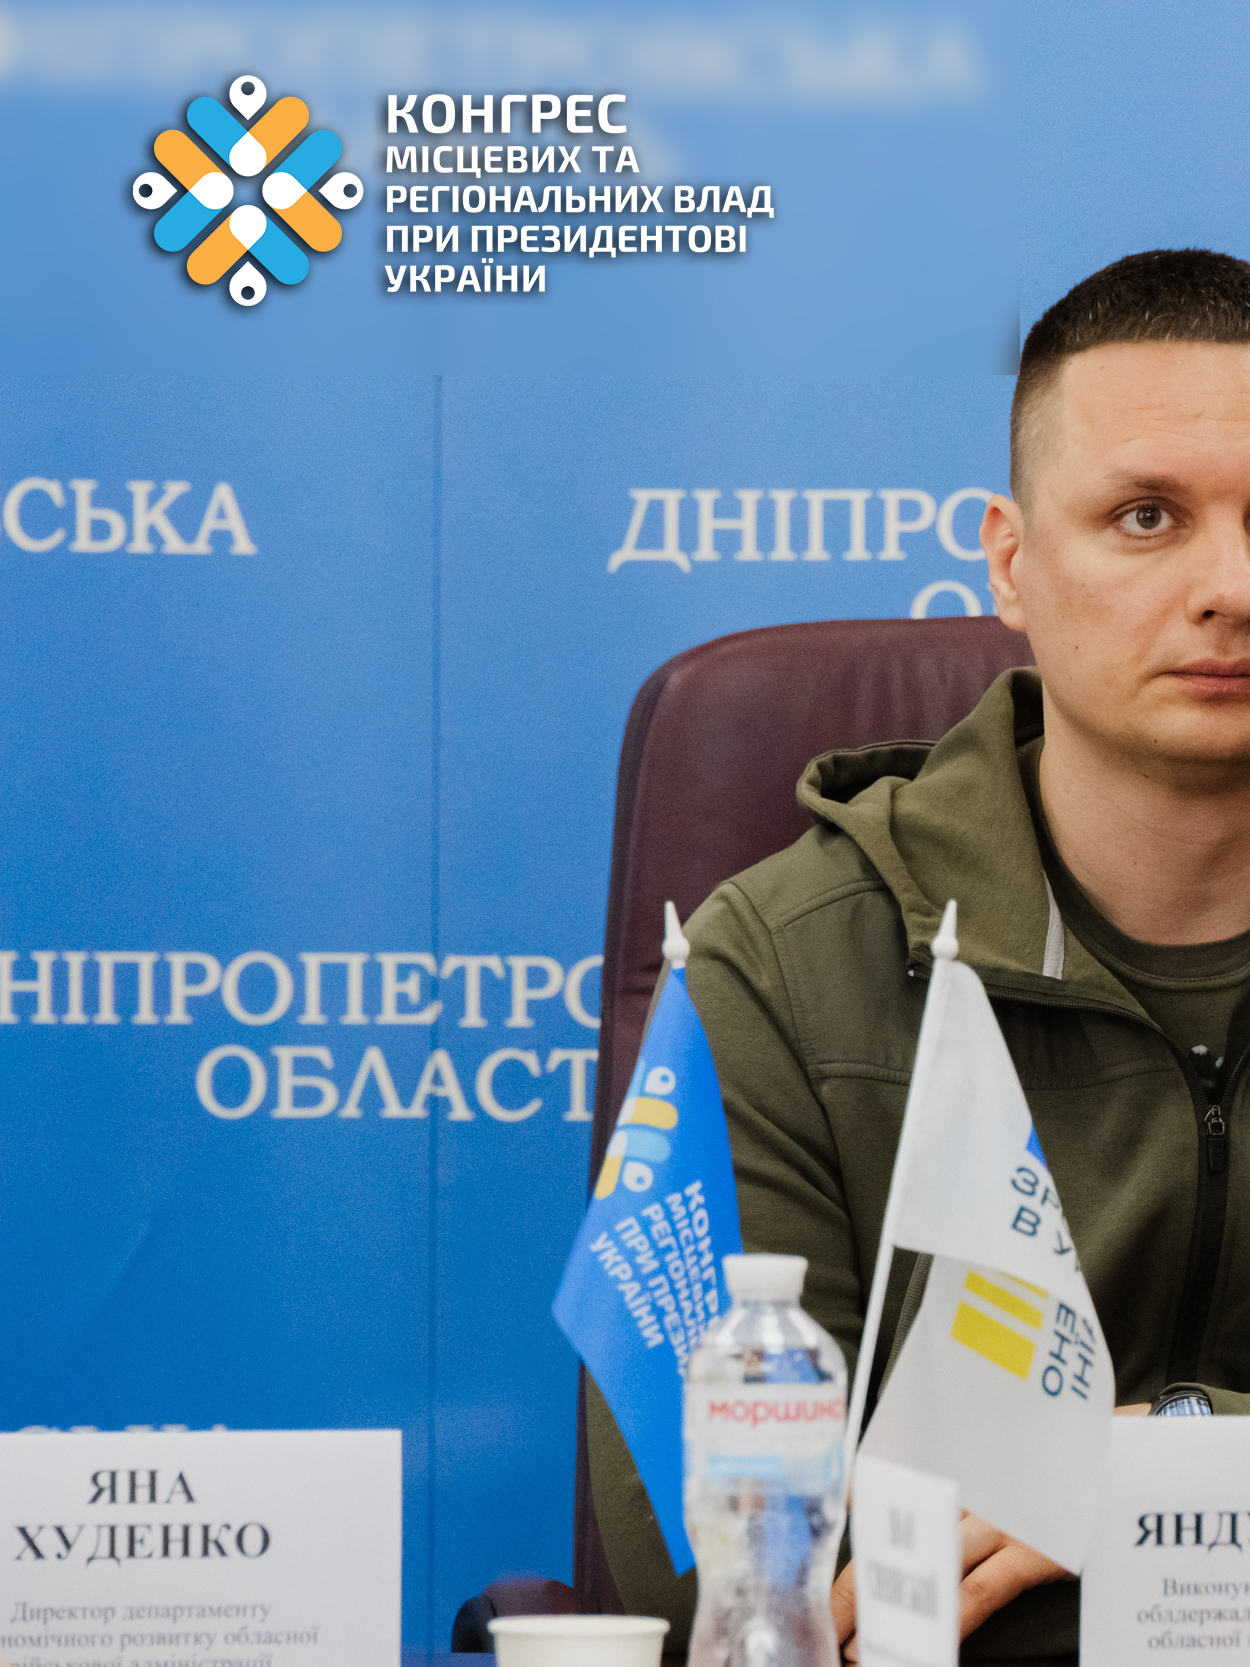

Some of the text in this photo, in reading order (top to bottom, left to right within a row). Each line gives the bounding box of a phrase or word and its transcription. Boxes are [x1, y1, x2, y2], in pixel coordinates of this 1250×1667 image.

[1, 476, 258, 557] СЬКА
[1011, 1166, 1061, 1210] ЗР
[589, 1231, 665, 1349] УКРАЇНИ
[87, 1469, 196, 1505] ЯНА
[14, 1523, 272, 1566] ХУДЕНКО
[10, 1601, 272, 1625] Директор департаменту
[120, 1630, 217, 1652] розвитку
[223, 1626, 319, 1646] обласної
[1147, 1627, 1241, 1650] обласної
